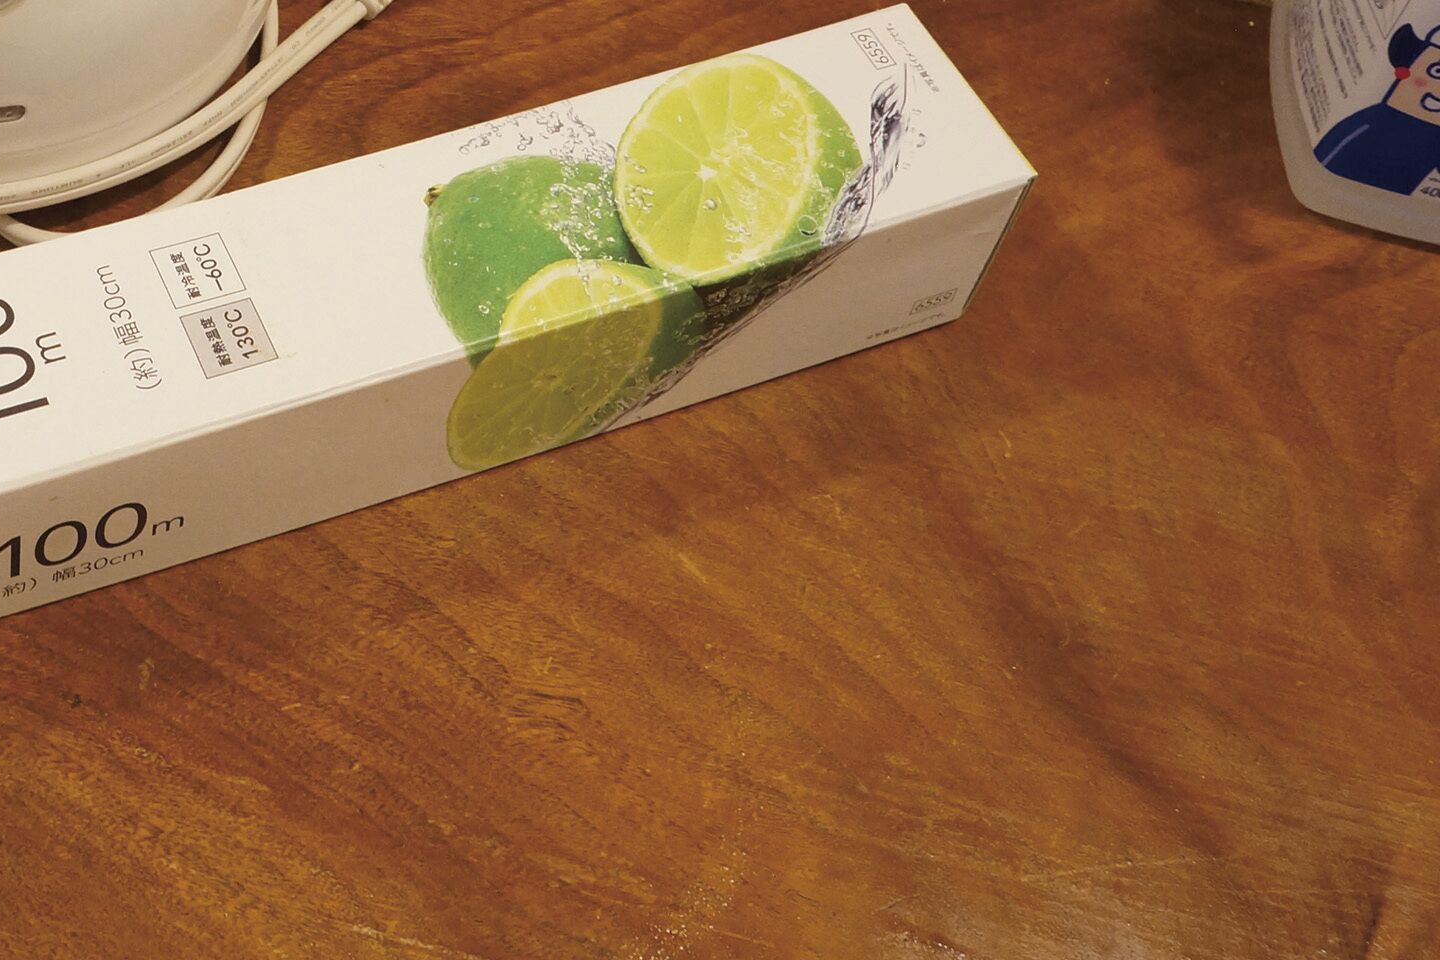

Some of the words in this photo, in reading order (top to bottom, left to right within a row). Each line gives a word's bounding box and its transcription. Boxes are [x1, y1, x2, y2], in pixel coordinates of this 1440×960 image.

[857, 34, 890, 64] 6559
[169, 251, 202, 300] 耐冷温度
[200, 316, 233, 368] 耐熱温度
